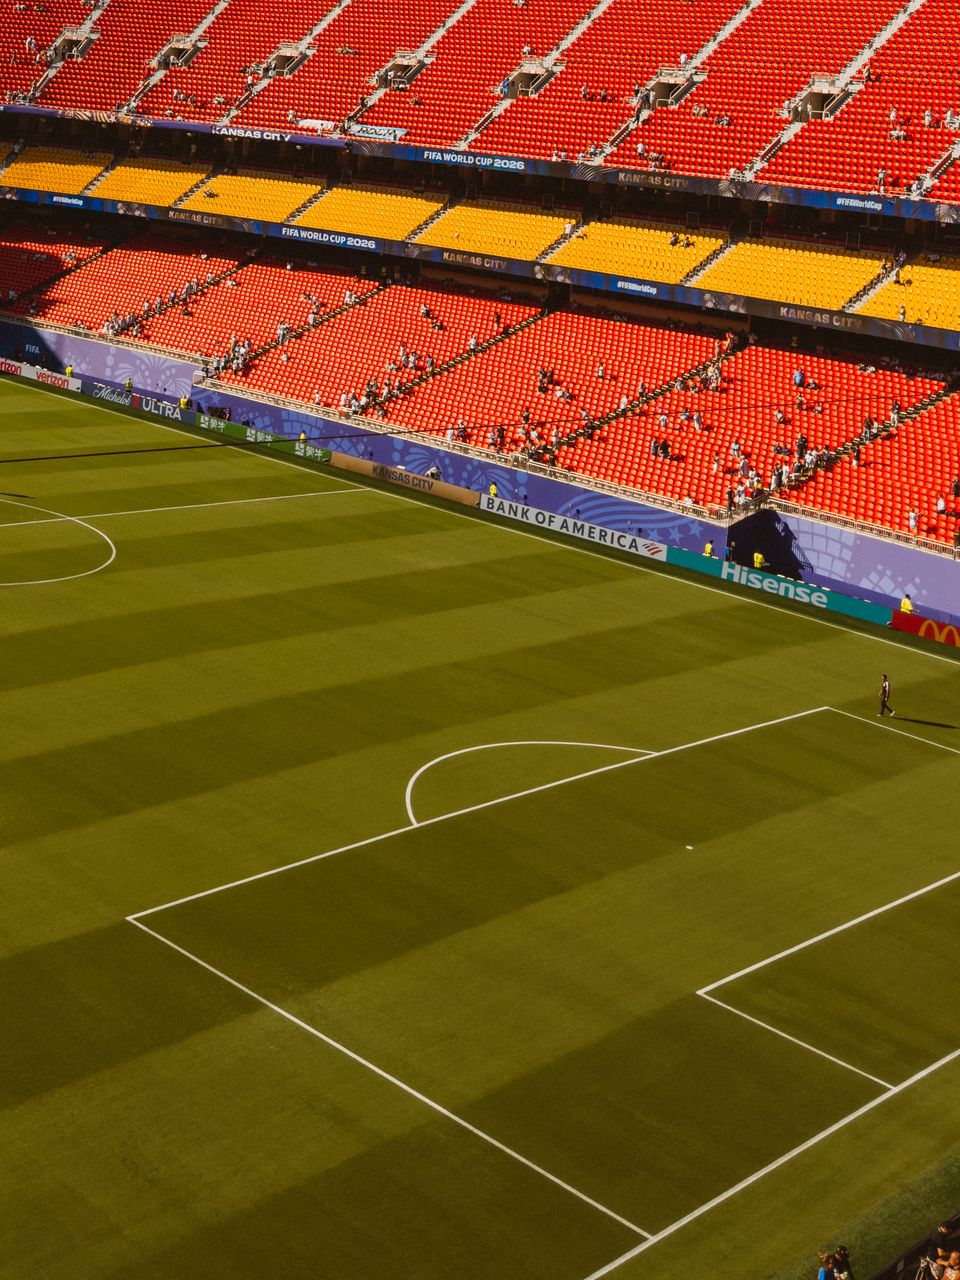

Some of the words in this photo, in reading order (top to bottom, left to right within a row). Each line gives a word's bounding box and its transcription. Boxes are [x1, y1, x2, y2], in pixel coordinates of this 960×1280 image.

[212, 126, 261, 139] KANSAS
[263, 132, 291, 142] CITY
[424, 151, 442, 160] FIFA
[443, 153, 474, 164] WORLD
[475, 157, 493, 166] CUP
[494, 159, 525, 170] 2026
[618, 172, 661, 185] KANSAS
[663, 177, 689, 188] CITY
[837, 197, 882, 211] #FIFAWorldCup
[168, 210, 202, 222] KANSAS
[282, 227, 299, 237] FIFA
[300, 230, 329, 241] WORLD
[330, 235, 347, 244] CUP
[346, 237, 376, 249] 2026
[443, 251, 482, 265] KANSAS
[484, 258, 507, 269] CITY
[780, 306, 830, 324] KANSAS
[833, 315, 862, 329] CITY
[25, 344, 40, 354] FIFA
[36, 370, 69, 389] verizon
[93, 386, 132, 406] Michelob
[142, 398, 182, 421] ULTRA
[372, 465, 410, 484] KANSAS
[412, 477, 434, 491] CITY
[486, 496, 529, 521] BANK
[536, 511, 556, 527] OF
[560, 515, 639, 552] AMERICA
[720, 561, 828, 609] Hisense
